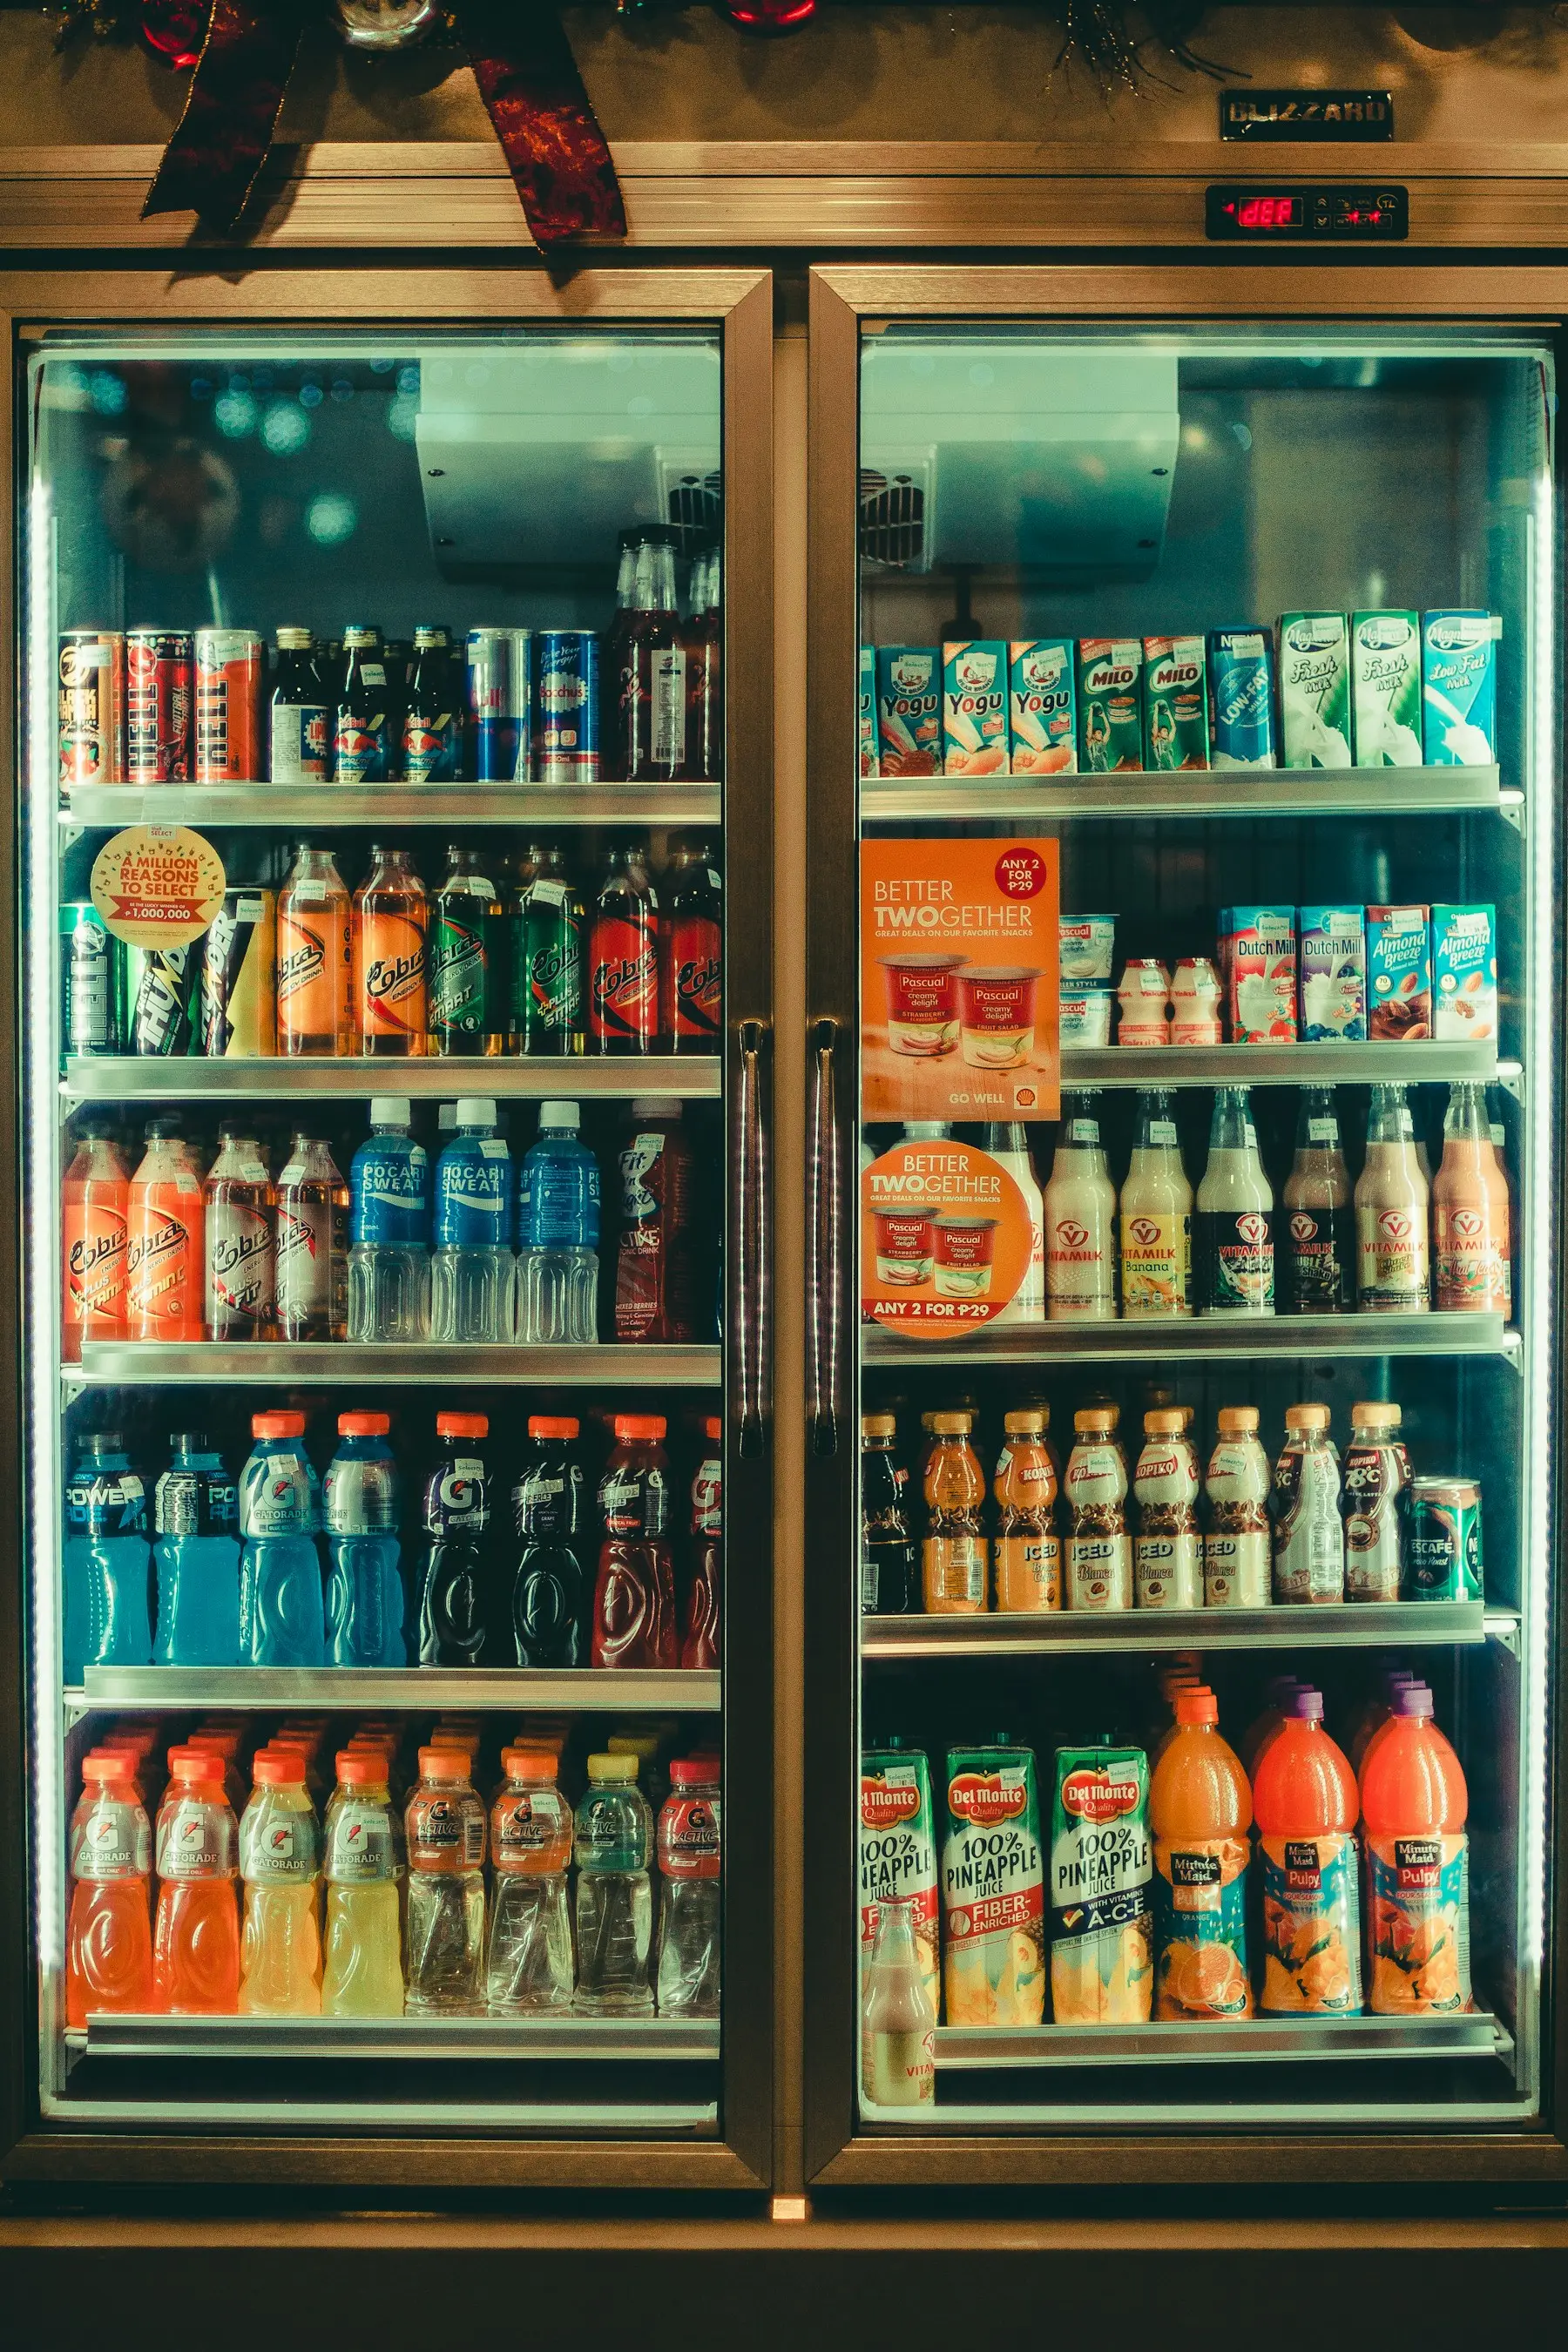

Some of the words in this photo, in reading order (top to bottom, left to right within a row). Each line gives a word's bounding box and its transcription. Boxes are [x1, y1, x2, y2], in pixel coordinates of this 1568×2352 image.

[1229, 102, 1385, 121] BLIZZARD
[1290, 654, 1338, 684] Fresh
[1362, 653, 1409, 682] Fresh
[1429, 662, 1457, 682] Low
[1456, 653, 1487, 674] Fat
[1092, 670, 1133, 687] MILO
[1157, 667, 1199, 685] MILO
[1375, 675, 1402, 692] Milk
[1446, 674, 1472, 691] Milk
[974, 678, 994, 693] BRAND
[1304, 678, 1332, 694] Milk
[950, 692, 1004, 716] Yogu
[1016, 691, 1069, 716] Yogu
[1220, 666, 1269, 726] LOW-FAT
[882, 694, 938, 719] Yogu
[128, 683, 159, 768] HELL
[197, 680, 228, 767] HELL
[122, 856, 132, 867] A
[137, 857, 198, 869] MILLION
[1001, 859, 1028, 869] ANY
[1032, 859, 1039, 869] 2
[120, 868, 199, 882] REASONS
[1009, 871, 1032, 880] FOR
[121, 882, 142, 894] TO
[145, 882, 197, 896] SELECT
[875, 880, 954, 902] BETTER
[133, 908, 190, 919] 1,000,000
[873, 905, 1032, 928] TWOGETHER
[1238, 940, 1274, 956] Dutch
[1275, 938, 1296, 956] Mill
[1304, 940, 1339, 956] Dutch
[1341, 938, 1362, 955] Mill
[1372, 930, 1427, 958] Almond
[1437, 929, 1491, 958] Almond
[1384, 946, 1422, 969] Breeze
[1449, 944, 1486, 968] Breeze
[902, 977, 944, 987] Pascual
[70, 956, 107, 1040] HELL
[549, 985, 573, 1010] PLUS
[911, 997, 938, 1008] delight
[977, 990, 1018, 1001] Pascual
[985, 1010, 1013, 1020] delight
[949, 1092, 970, 1104] GO
[973, 1093, 1005, 1104] WELL
[619, 1152, 645, 1171] Fit
[903, 1154, 969, 1173] BETTER
[363, 1165, 425, 1179] POCARI
[442, 1166, 505, 1179] POCARI
[362, 1178, 422, 1191] SWEAT
[441, 1179, 500, 1192] SWEAT
[869, 1175, 1001, 1194] TWOGETHER
[889, 1222, 923, 1233] Pascual
[946, 1234, 981, 1245] Pascual
[1363, 1241, 1425, 1253] VITAMILK
[1125, 1260, 1169, 1272] Banana
[234, 1279, 261, 1309] FIT
[873, 1302, 908, 1315] ANY
[911, 1302, 922, 1315] 2
[925, 1303, 957, 1315] FOR
[1349, 1455, 1376, 1466] KOPIKO
[1135, 1462, 1173, 1478] KOPIKO
[253, 1510, 308, 1520] GATORADE
[1024, 1542, 1058, 1561] ICED
[1072, 1543, 1114, 1561] ICED
[1136, 1541, 1173, 1560] ICED
[1077, 1564, 1115, 1580] Blanca
[1139, 1563, 1173, 1580] Blanca
[870, 1791, 915, 1806] Monte
[952, 1789, 975, 1804] Del
[977, 1788, 1022, 1803] Monte
[1067, 1786, 1090, 1801] Del
[1091, 1785, 1135, 1800] Monte
[864, 1807, 897, 1820] Quality
[970, 1804, 1004, 1817] Quality
[1085, 1801, 1117, 1815] Quality
[419, 1823, 459, 1835] ACTIVE
[504, 1825, 544, 1836] ACTIVE
[580, 1821, 616, 1834] ACTIVE
[678, 1830, 717, 1842] ACTIVE
[1076, 1828, 1136, 1860] 100%
[961, 1832, 1023, 1862] 100%
[1289, 1846, 1316, 1855] Minute
[1399, 1843, 1439, 1854] Minute
[79, 1850, 132, 1862] GATORADE
[164, 1851, 218, 1863] GATORADE
[252, 1857, 306, 1869] GATORADE
[330, 1854, 382, 1864] GATORADE
[1174, 1857, 1218, 1870] Minute
[1293, 1855, 1314, 1865] Maid
[1405, 1854, 1436, 1863] Maid
[947, 1845, 1037, 1892] PINEAPPLE
[1058, 1841, 1148, 1889] PINEAPPLE
[1179, 1869, 1213, 1882] Maid
[1289, 1871, 1321, 1889] Pulpy
[1402, 1869, 1439, 1886] Pulpy
[869, 1882, 898, 1903] JUICE
[974, 1880, 1004, 1899] JUICE
[1087, 1876, 1116, 1896] JUICE
[972, 1895, 1031, 1917] FIBER-
[1087, 1898, 1108, 1910] WITH
[1109, 1888, 1144, 1907] VITAMINS
[972, 1909, 1030, 1933] ENRICHED
[1087, 1896, 1145, 1930] A-C-E
